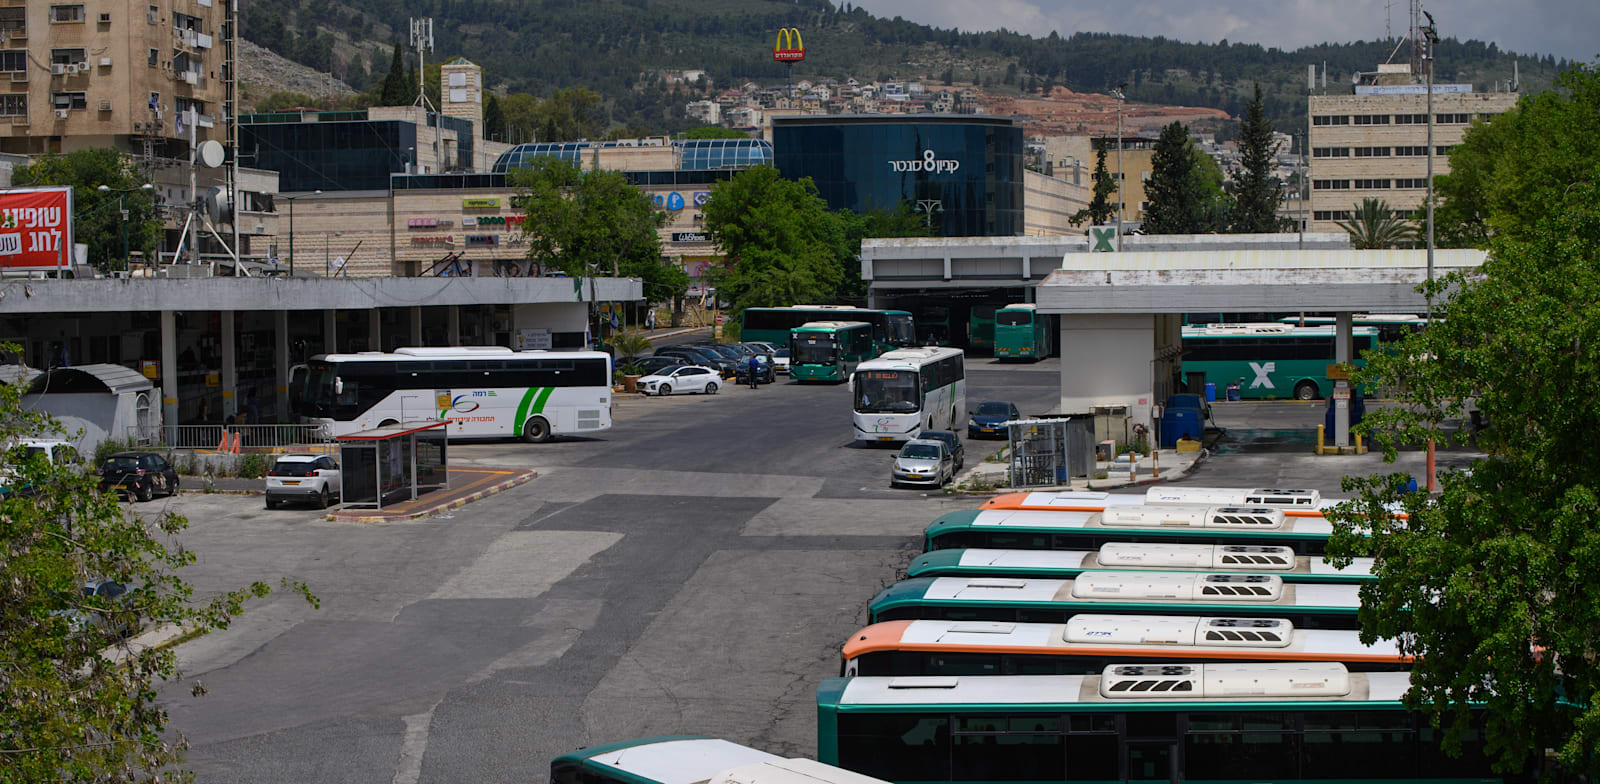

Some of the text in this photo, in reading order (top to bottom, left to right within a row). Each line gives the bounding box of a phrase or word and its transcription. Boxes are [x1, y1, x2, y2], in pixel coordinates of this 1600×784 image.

[888, 149, 960, 174] קניון 8 סנטר
[1, 207, 61, 228] שופינג
[28, 228, 62, 252] לחג
